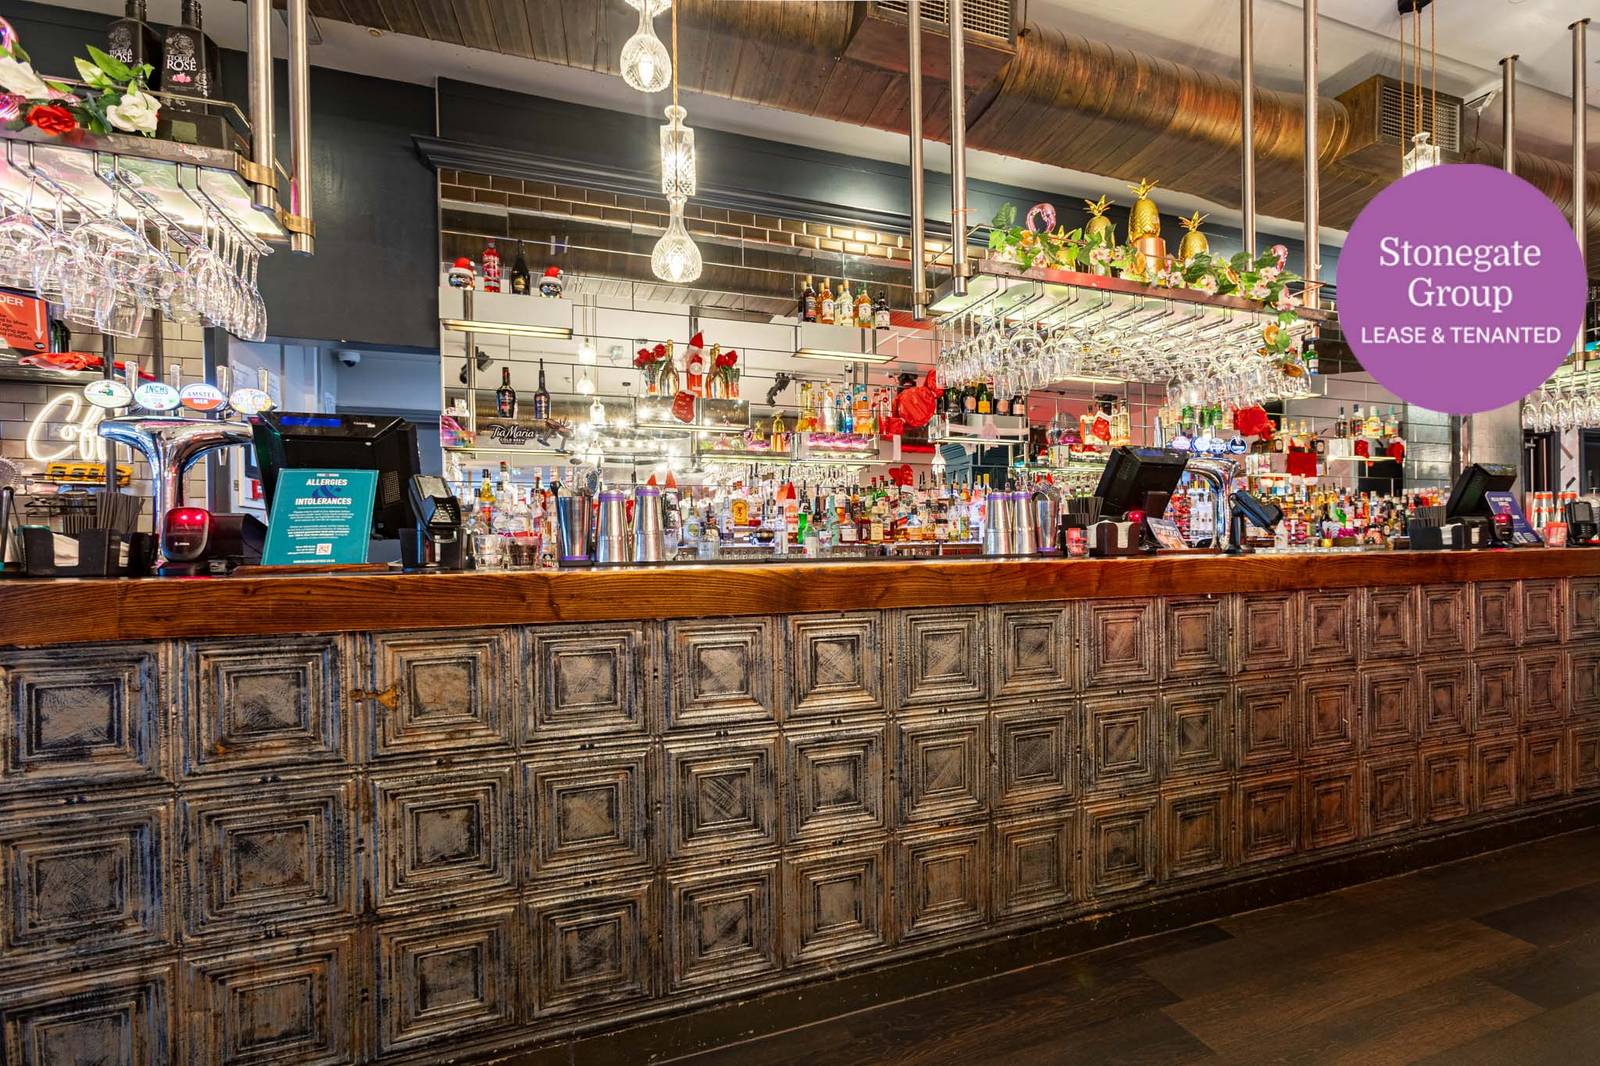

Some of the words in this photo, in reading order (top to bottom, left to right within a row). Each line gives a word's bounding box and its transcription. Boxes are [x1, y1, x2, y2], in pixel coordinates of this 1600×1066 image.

[168, 55, 195, 63] TEQUILA
[167, 60, 197, 71] ROSE
[490, 424, 506, 439] Tia
[505, 425, 535, 439] Maria
